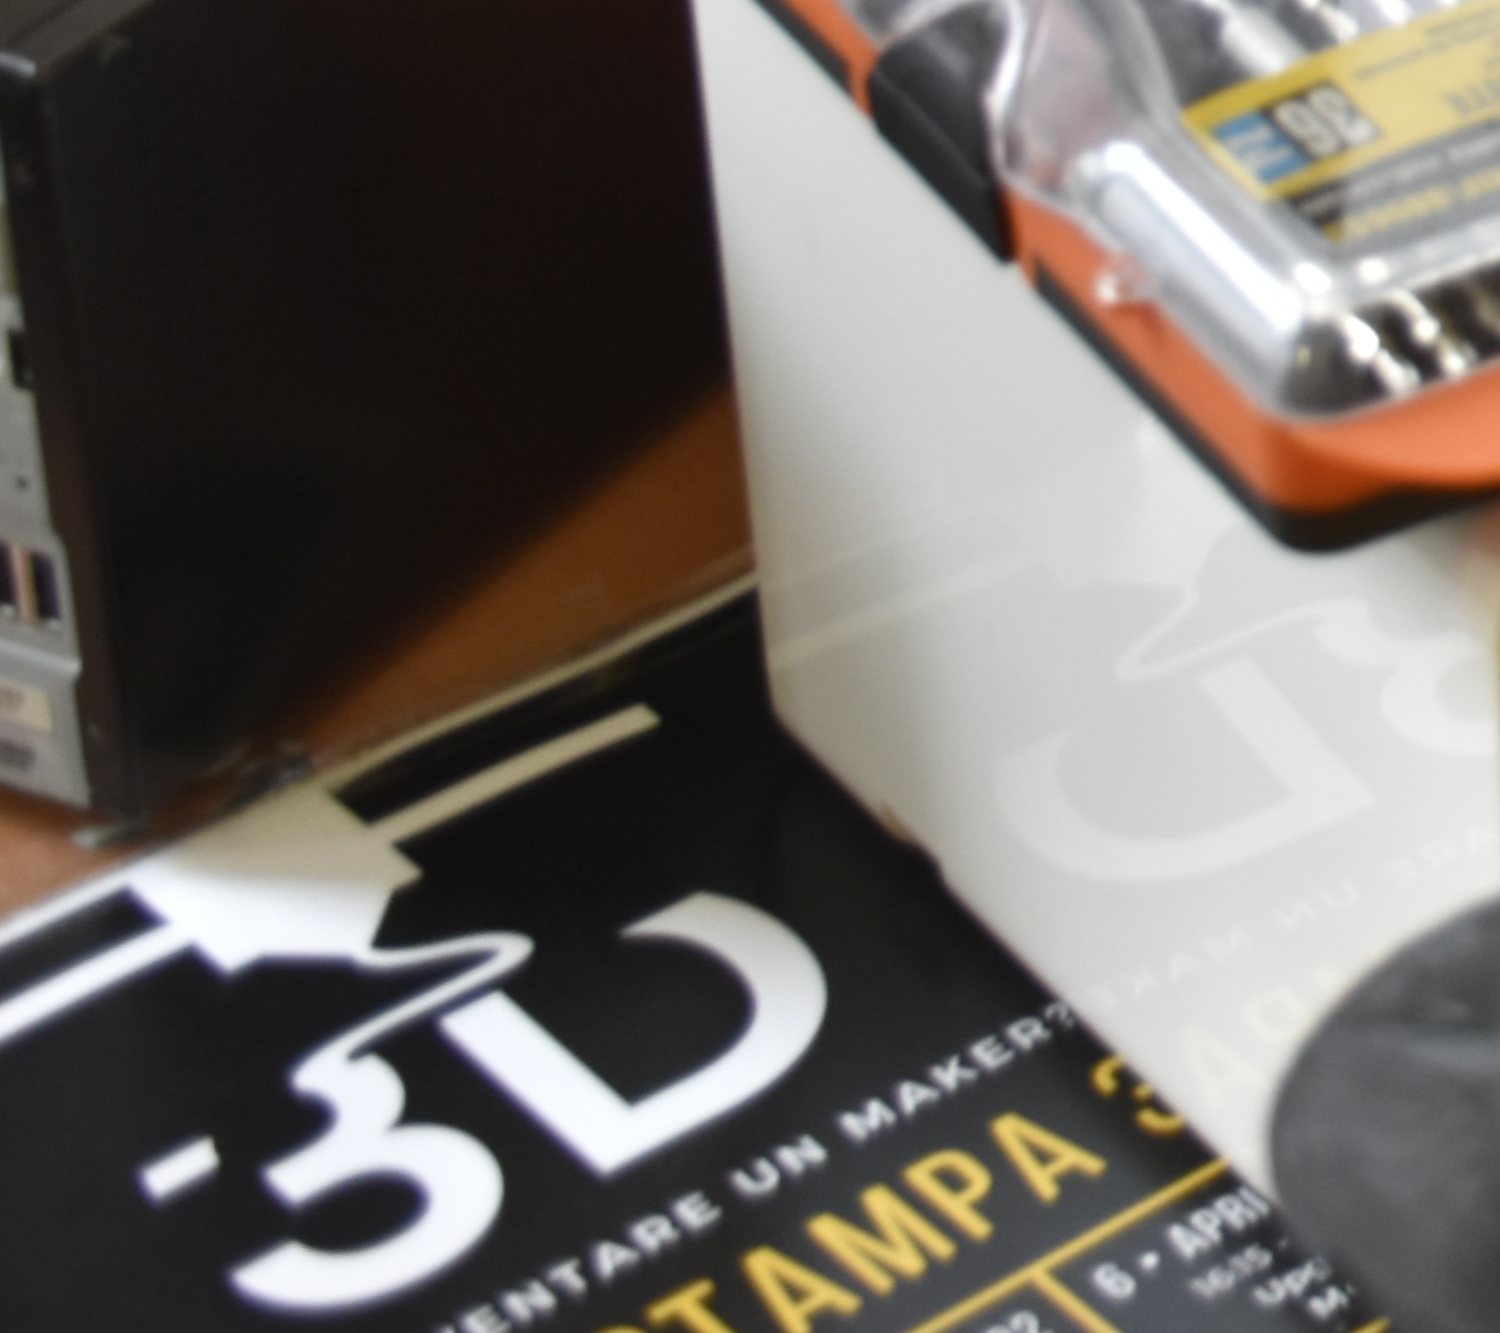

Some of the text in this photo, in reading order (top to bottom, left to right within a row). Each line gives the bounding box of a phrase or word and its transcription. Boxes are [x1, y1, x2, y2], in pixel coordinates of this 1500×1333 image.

[730, 1134, 829, 1199] UN
[837, 999, 1078, 1141] MAKER?
[603, 1111, 1108, 1333] TAMPA
[1092, 1261, 1137, 1301] 6
